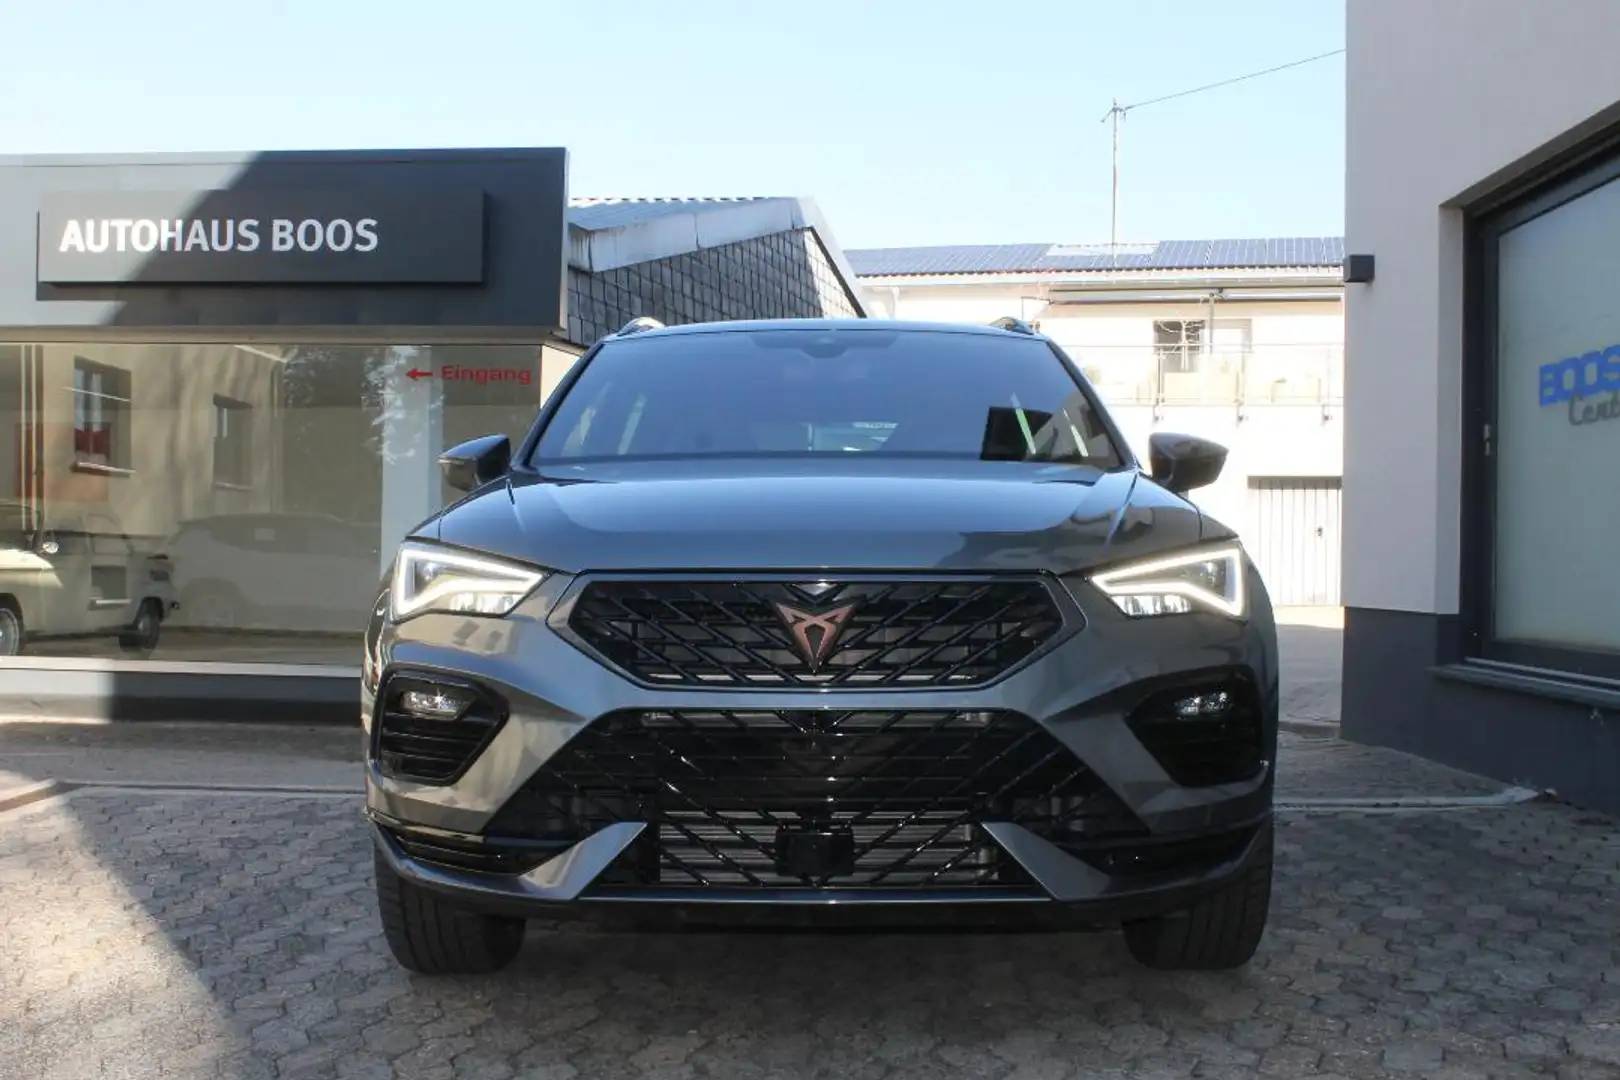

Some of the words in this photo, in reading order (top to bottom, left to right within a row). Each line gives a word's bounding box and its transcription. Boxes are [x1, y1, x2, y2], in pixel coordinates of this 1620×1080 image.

[59, 218, 260, 252] AUTOHAUS
[271, 218, 379, 252] BOOS
[441, 365, 531, 385] Eingang
